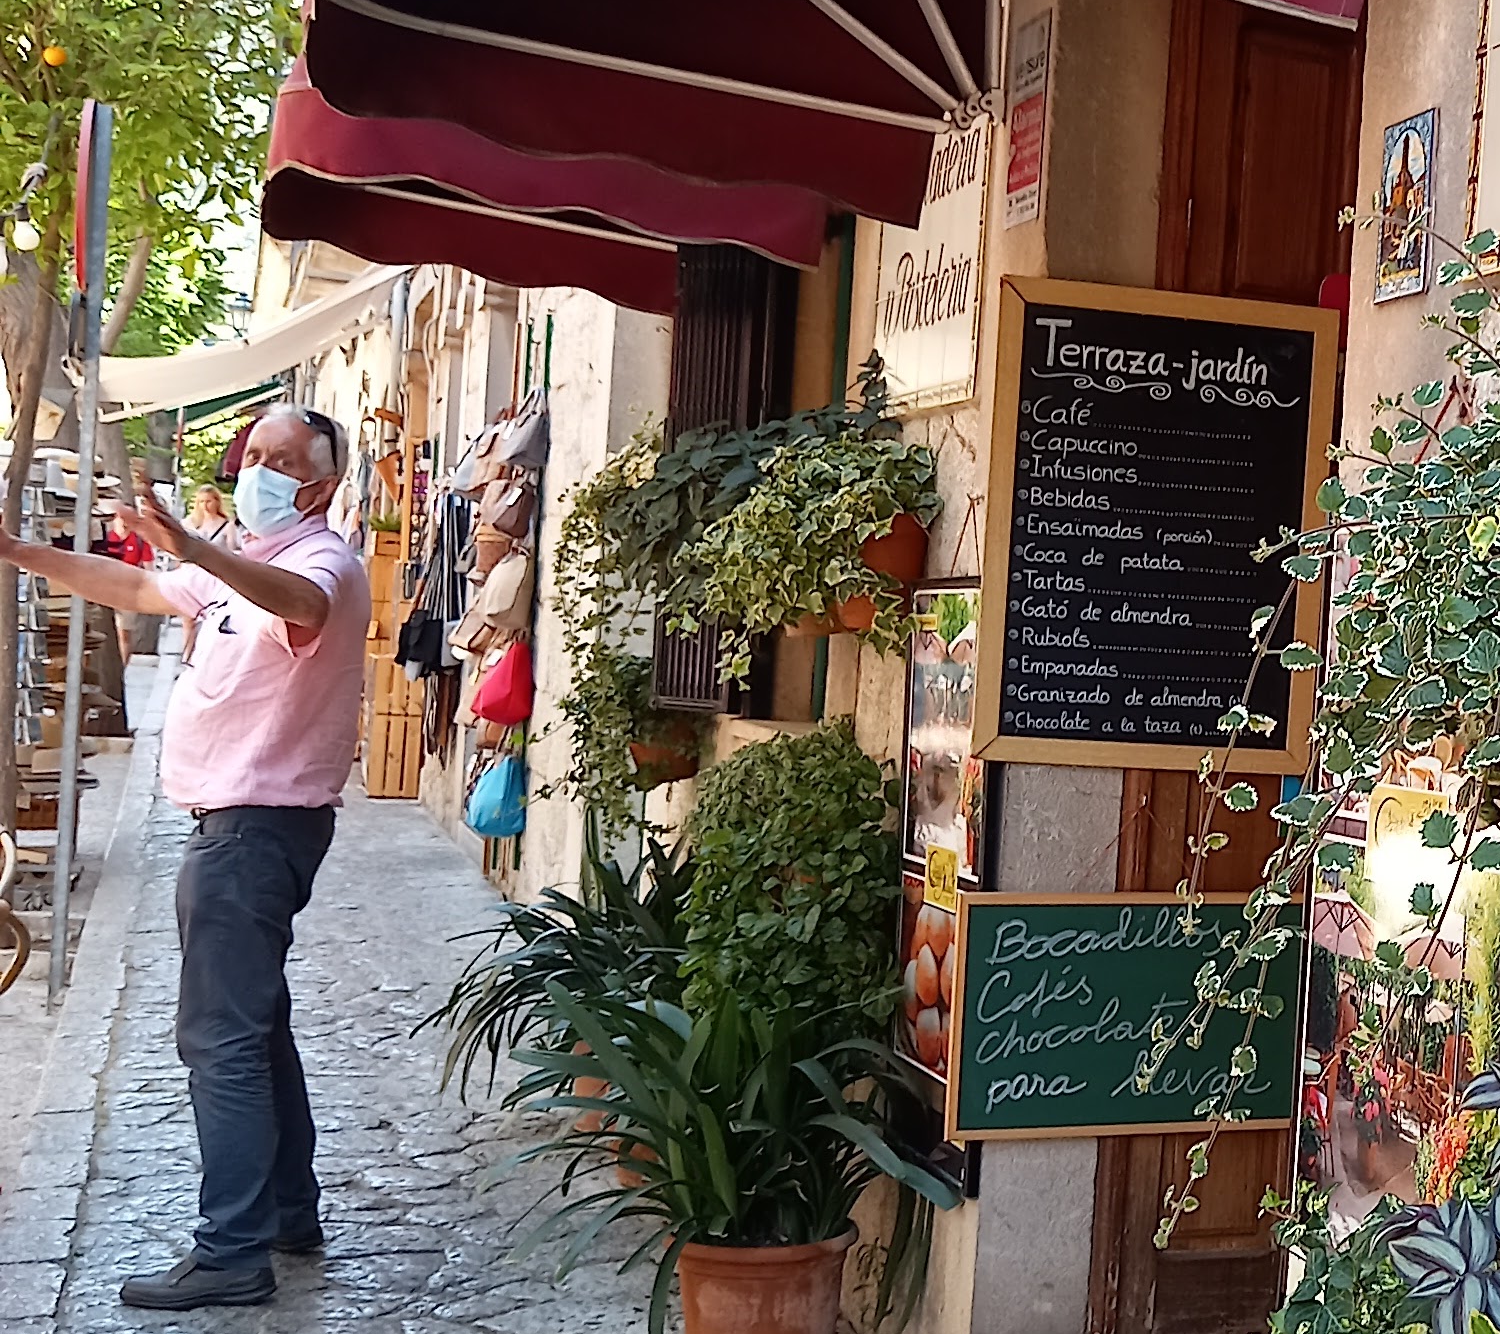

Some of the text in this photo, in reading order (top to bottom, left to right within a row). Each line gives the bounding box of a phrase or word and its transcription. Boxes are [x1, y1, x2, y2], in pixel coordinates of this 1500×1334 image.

[1035, 317, 1269, 390] Terraza-jardín
[1032, 394, 1095, 426] Café
[1030, 428, 1138, 460] Capuccino
[1029, 454, 1138, 484] Infusiones
[1029, 486, 1111, 511] Bebidas
[1156, 527, 1213, 546] (porción)
[1023, 542, 1185, 575] Coca de patata
[1022, 569, 1086, 593] Tartas
[1021, 595, 1194, 627] Gató de almendra
[1021, 626, 1091, 649] Rubiols
[1020, 654, 1119, 680] Empanadas
[1017, 683, 1111, 704] Granizado
[1124, 687, 1145, 707] de
[1150, 687, 1225, 709] almendra
[1014, 710, 1091, 733] Chocolate
[1101, 720, 1114, 733] a
[1120, 716, 1137, 733] la
[1145, 717, 1183, 734] taza
[976, 964, 1094, 1024] Cafés
[985, 1073, 1088, 1115] para
